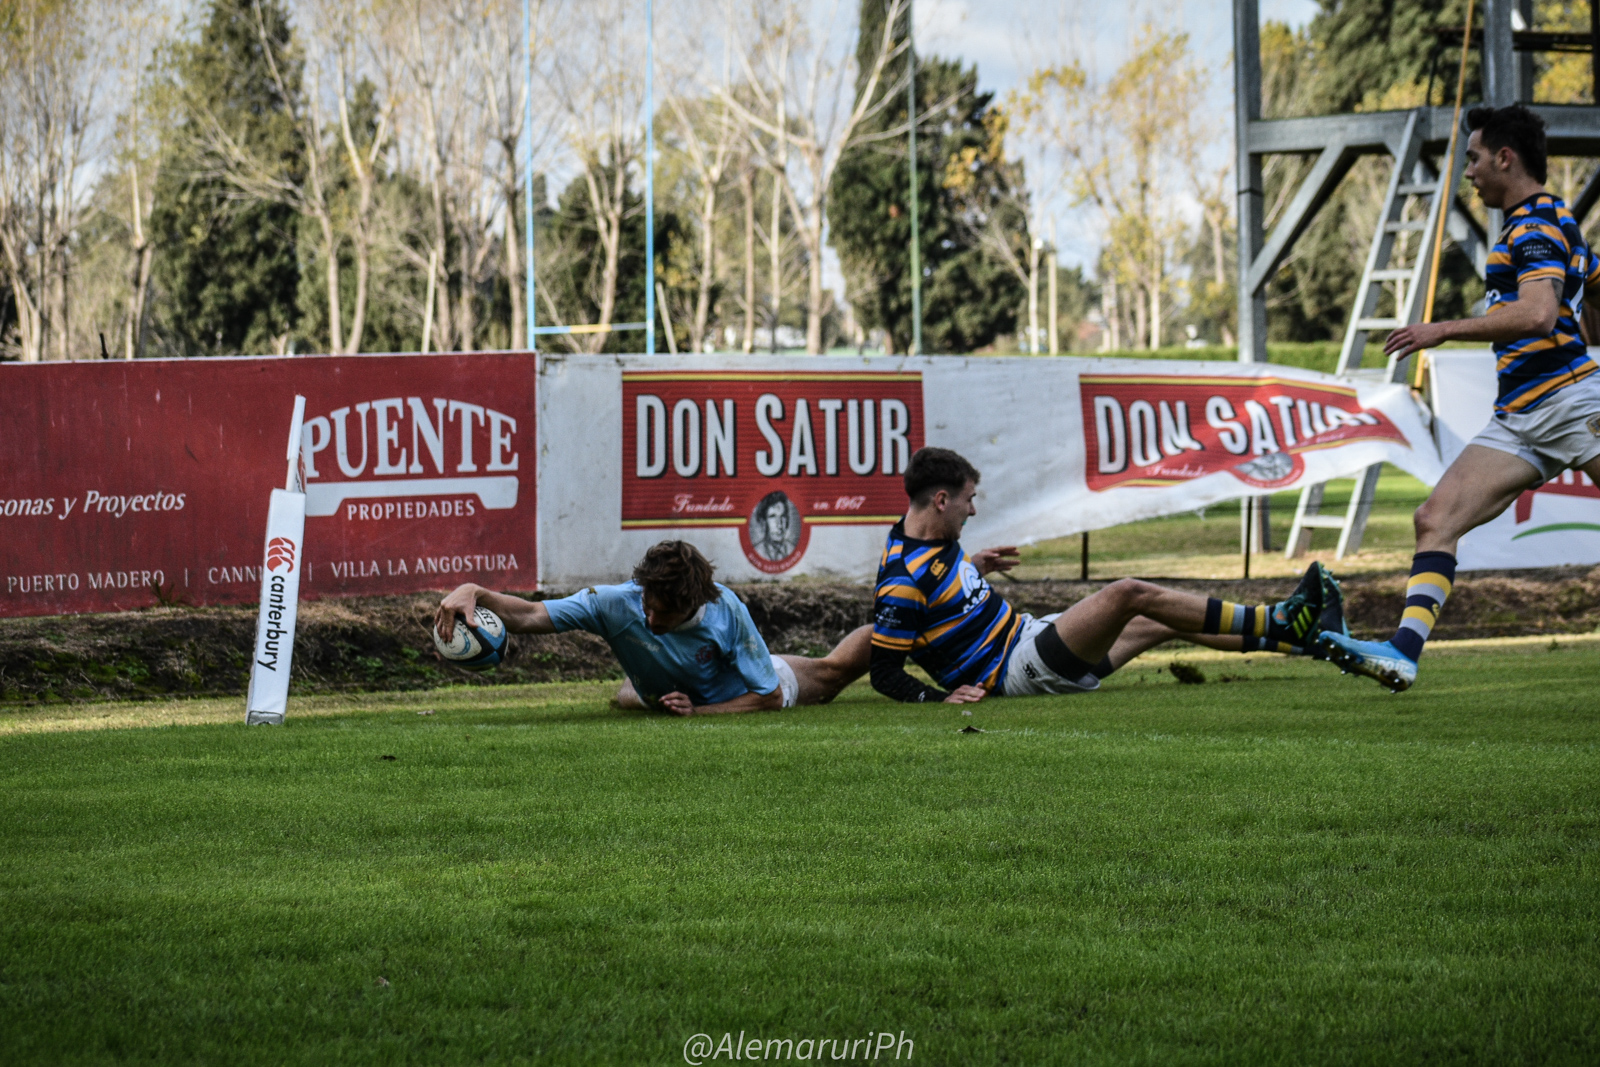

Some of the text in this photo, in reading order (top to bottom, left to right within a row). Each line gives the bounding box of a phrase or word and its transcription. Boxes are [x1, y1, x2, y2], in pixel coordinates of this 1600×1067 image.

[303, 397, 519, 478] PUENTE
[636, 393, 911, 479] DON SATUR
[1094, 395, 1205, 474] DON
[58, 498, 77, 521] y
[83, 490, 187, 518] Proyectos
[347, 500, 476, 521] PROPIEDADES
[672, 493, 734, 513] Fundado
[835, 496, 866, 510] 1967
[7, 553, 519, 594] PUERTO MADERO CANNI VILLA LA ANGOSTURA
[257, 575, 288, 672] canterbury
